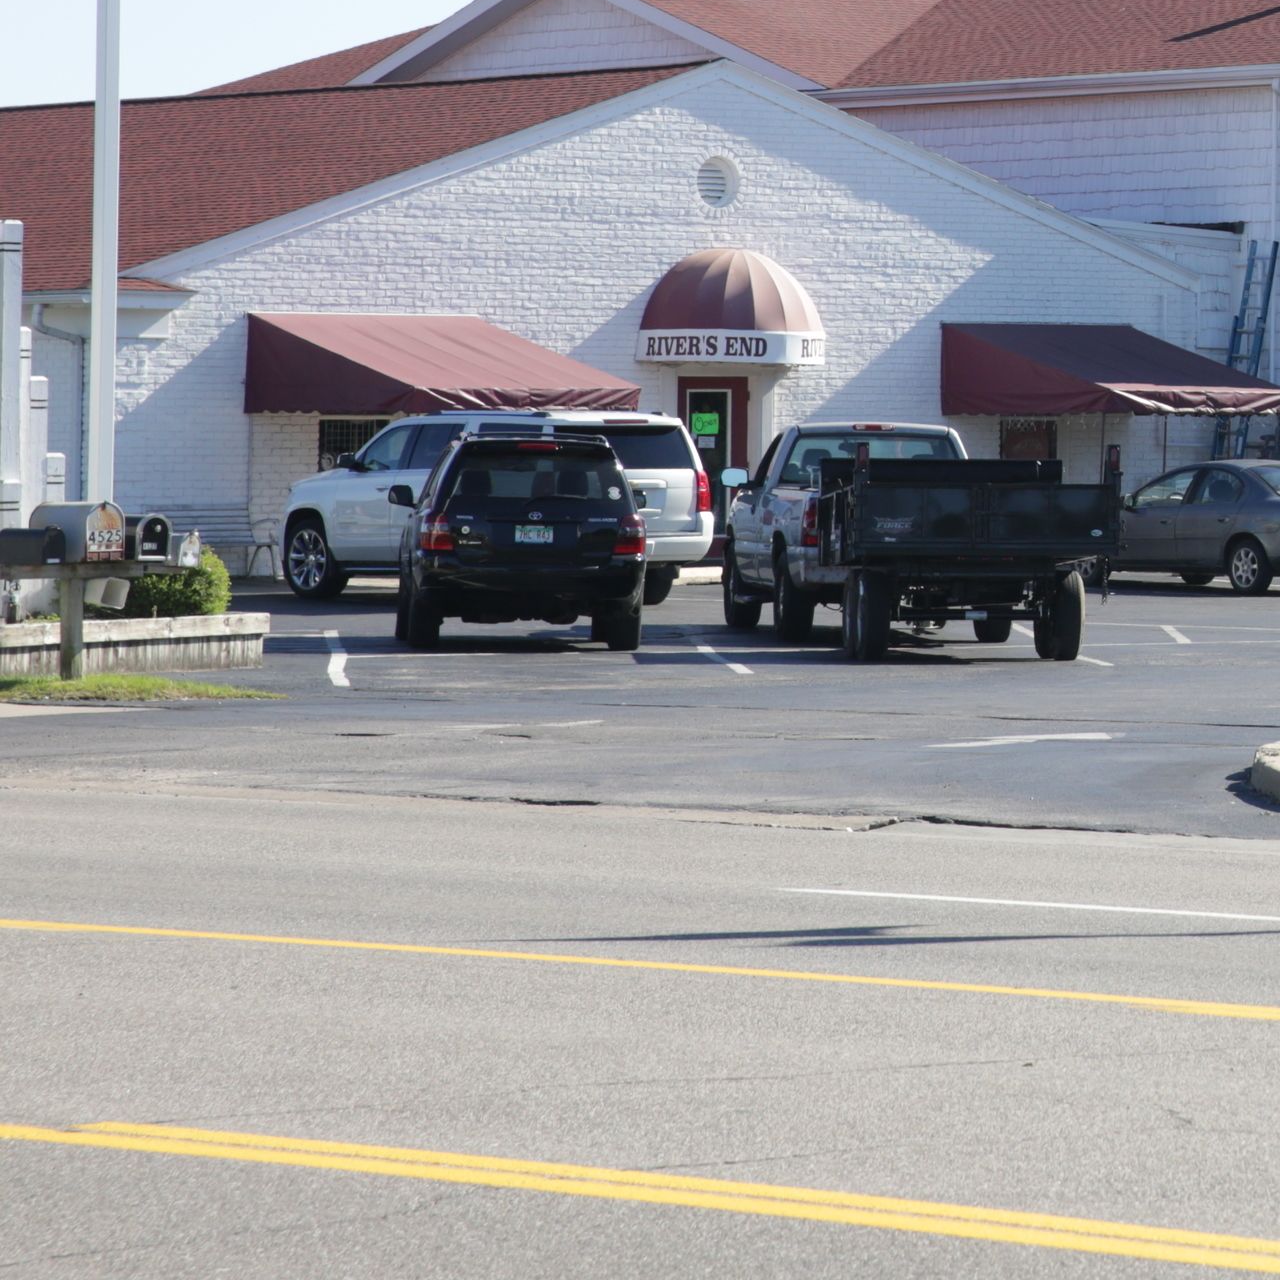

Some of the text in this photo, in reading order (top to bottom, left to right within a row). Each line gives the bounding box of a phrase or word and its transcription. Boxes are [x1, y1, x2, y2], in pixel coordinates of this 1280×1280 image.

[646, 335, 768, 357] RIVER'S END
[89, 530, 122, 543] 4525
